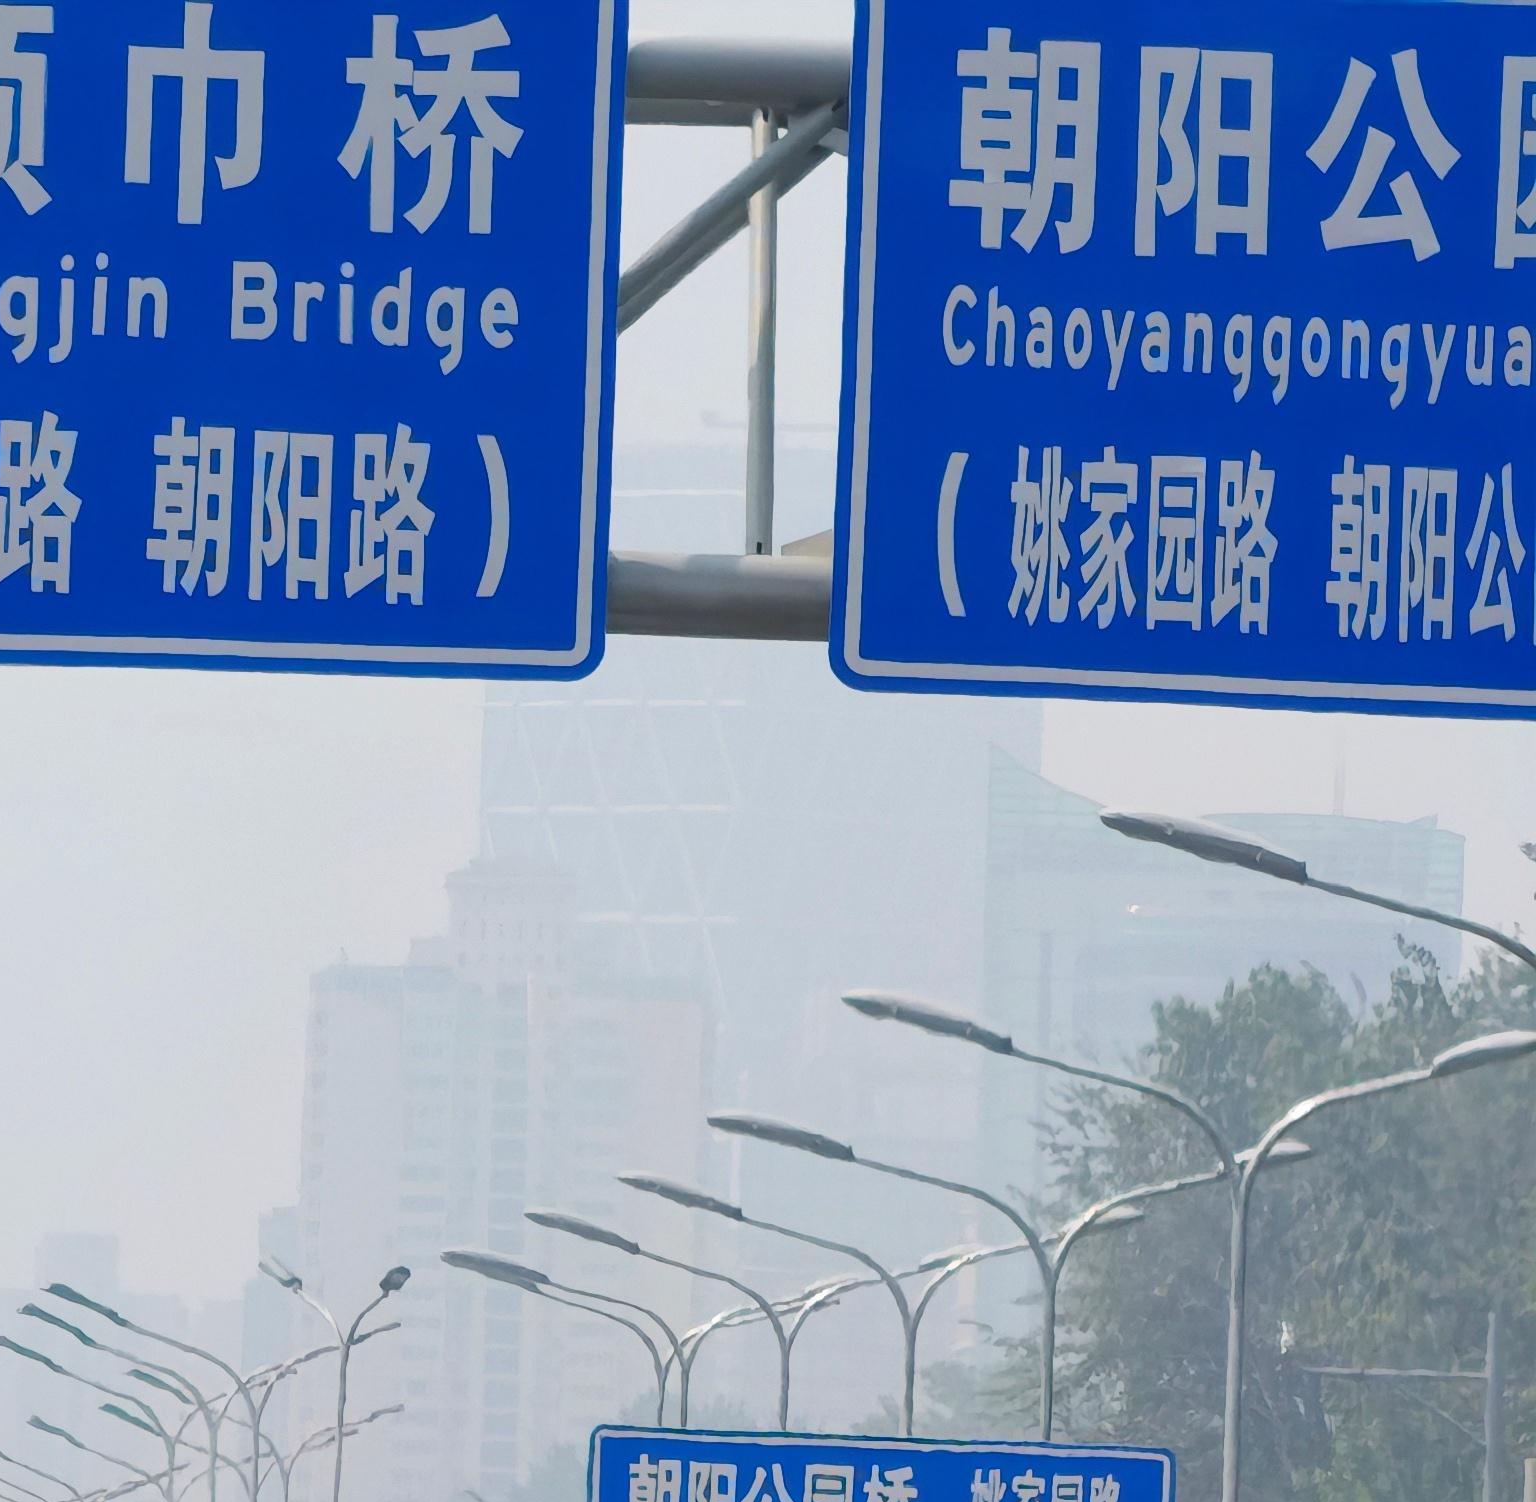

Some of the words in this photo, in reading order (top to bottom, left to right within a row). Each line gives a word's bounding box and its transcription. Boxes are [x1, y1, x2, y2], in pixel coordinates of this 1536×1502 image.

[230, 261, 519, 375] Bridge
[943, 285, 1533, 409] Chaoyanggongyua
[1326, 455, 1536, 642] 朝阳公
